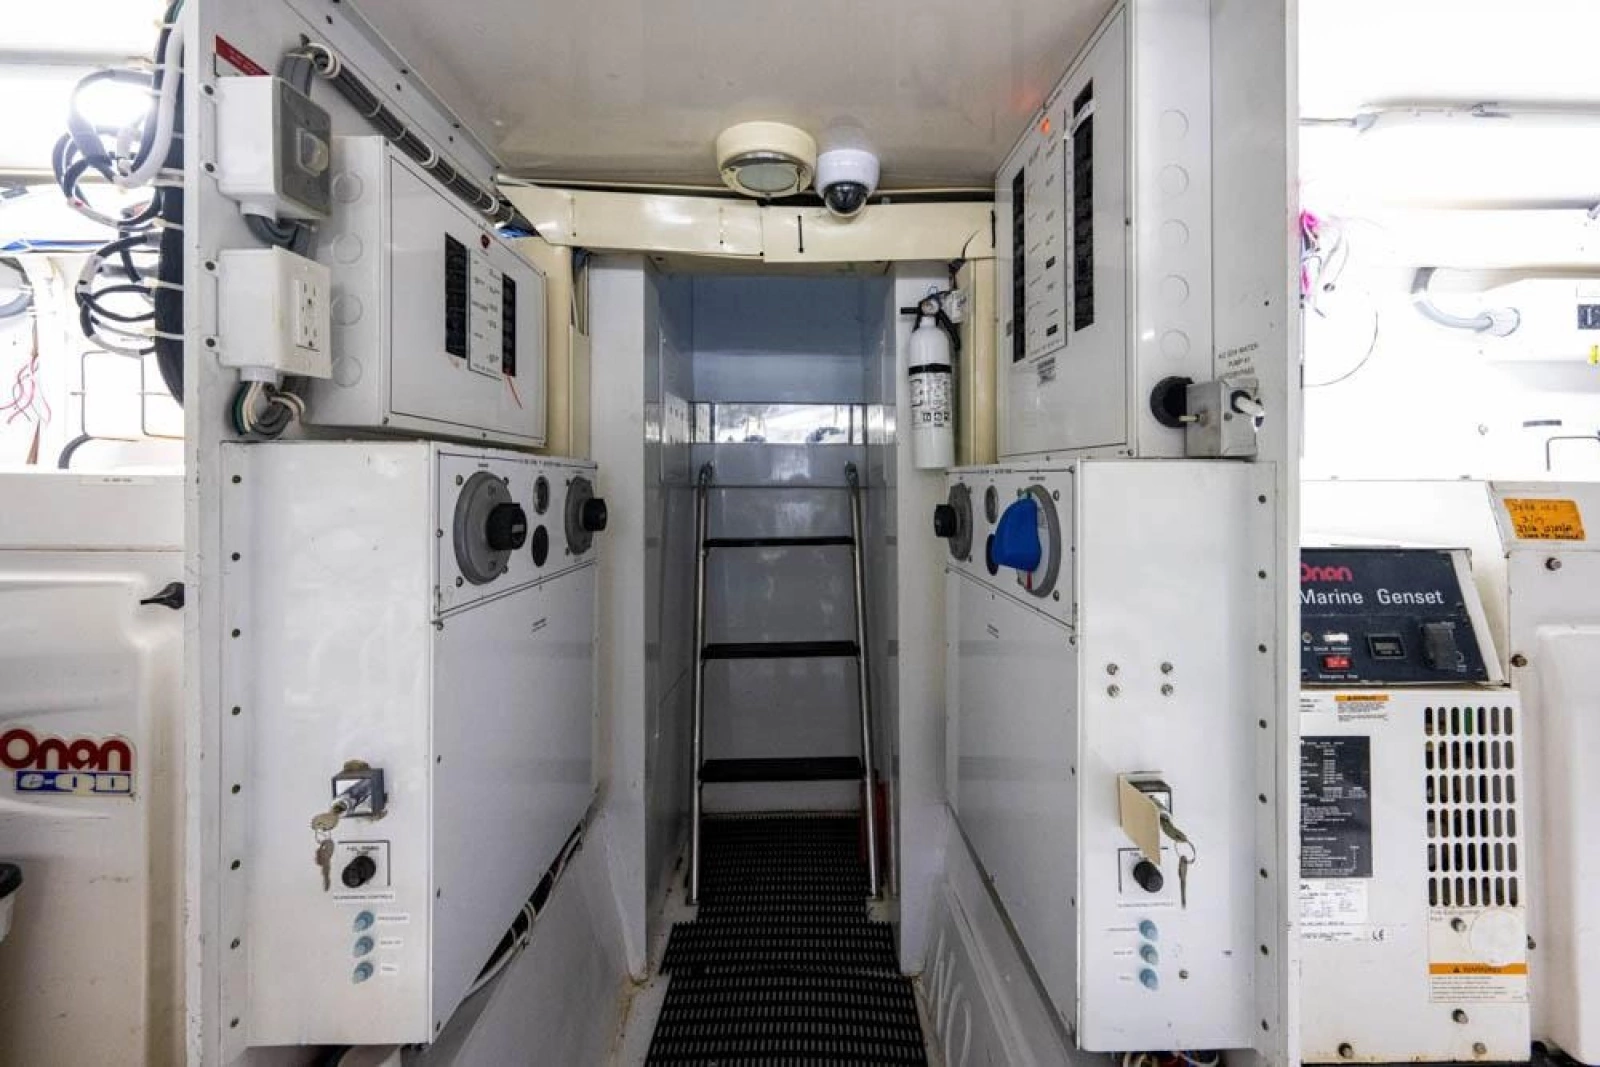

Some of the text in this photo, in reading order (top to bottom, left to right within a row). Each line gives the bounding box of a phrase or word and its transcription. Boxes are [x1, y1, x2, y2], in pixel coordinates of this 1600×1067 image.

[1300, 588, 1444, 604] Marine Genset
[0, 729, 131, 771] Onan
